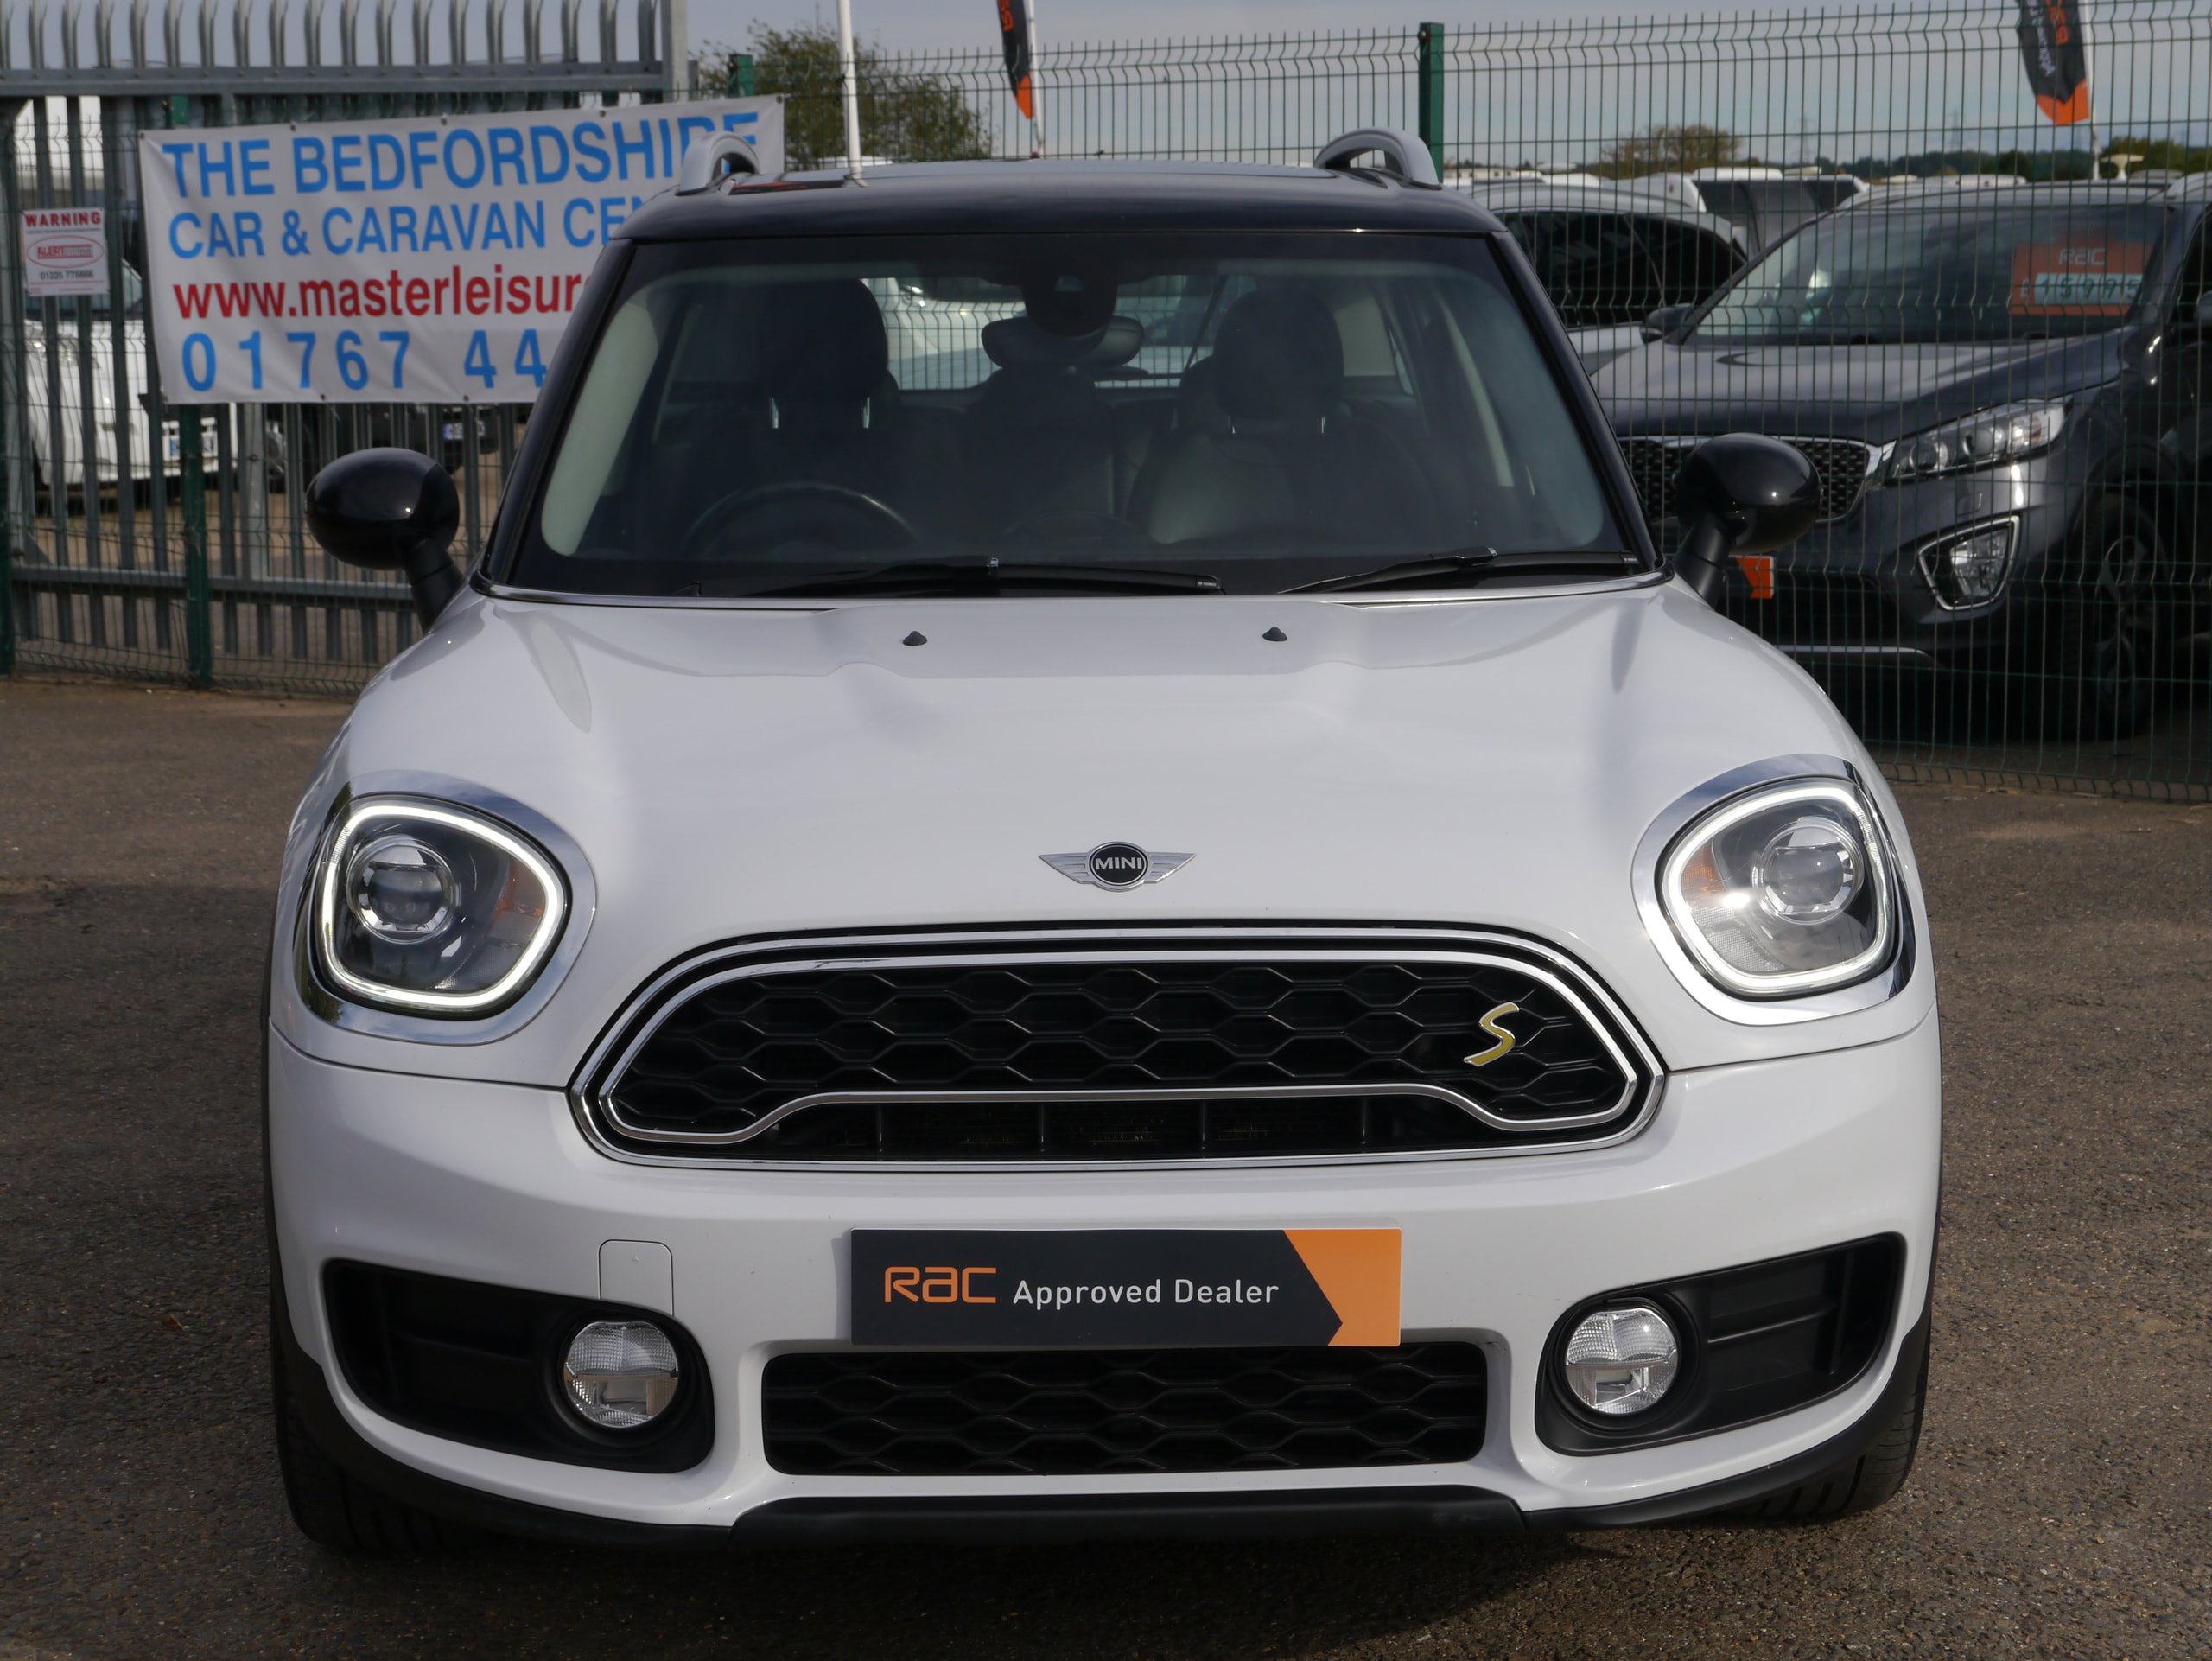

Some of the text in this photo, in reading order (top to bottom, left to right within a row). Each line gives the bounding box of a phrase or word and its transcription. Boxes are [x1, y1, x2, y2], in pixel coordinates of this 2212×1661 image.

[162, 138, 275, 198] THE
[25, 211, 101, 227] WARNING
[168, 196, 643, 259] CAR & CARAVAN CE
[174, 264, 591, 319] www.masterleisur
[1095, 856, 1143, 871] MINI
[1463, 1002, 1519, 1066] S
[1013, 1279, 1161, 1311] Approved
[1175, 1279, 1280, 1305] Dealer
